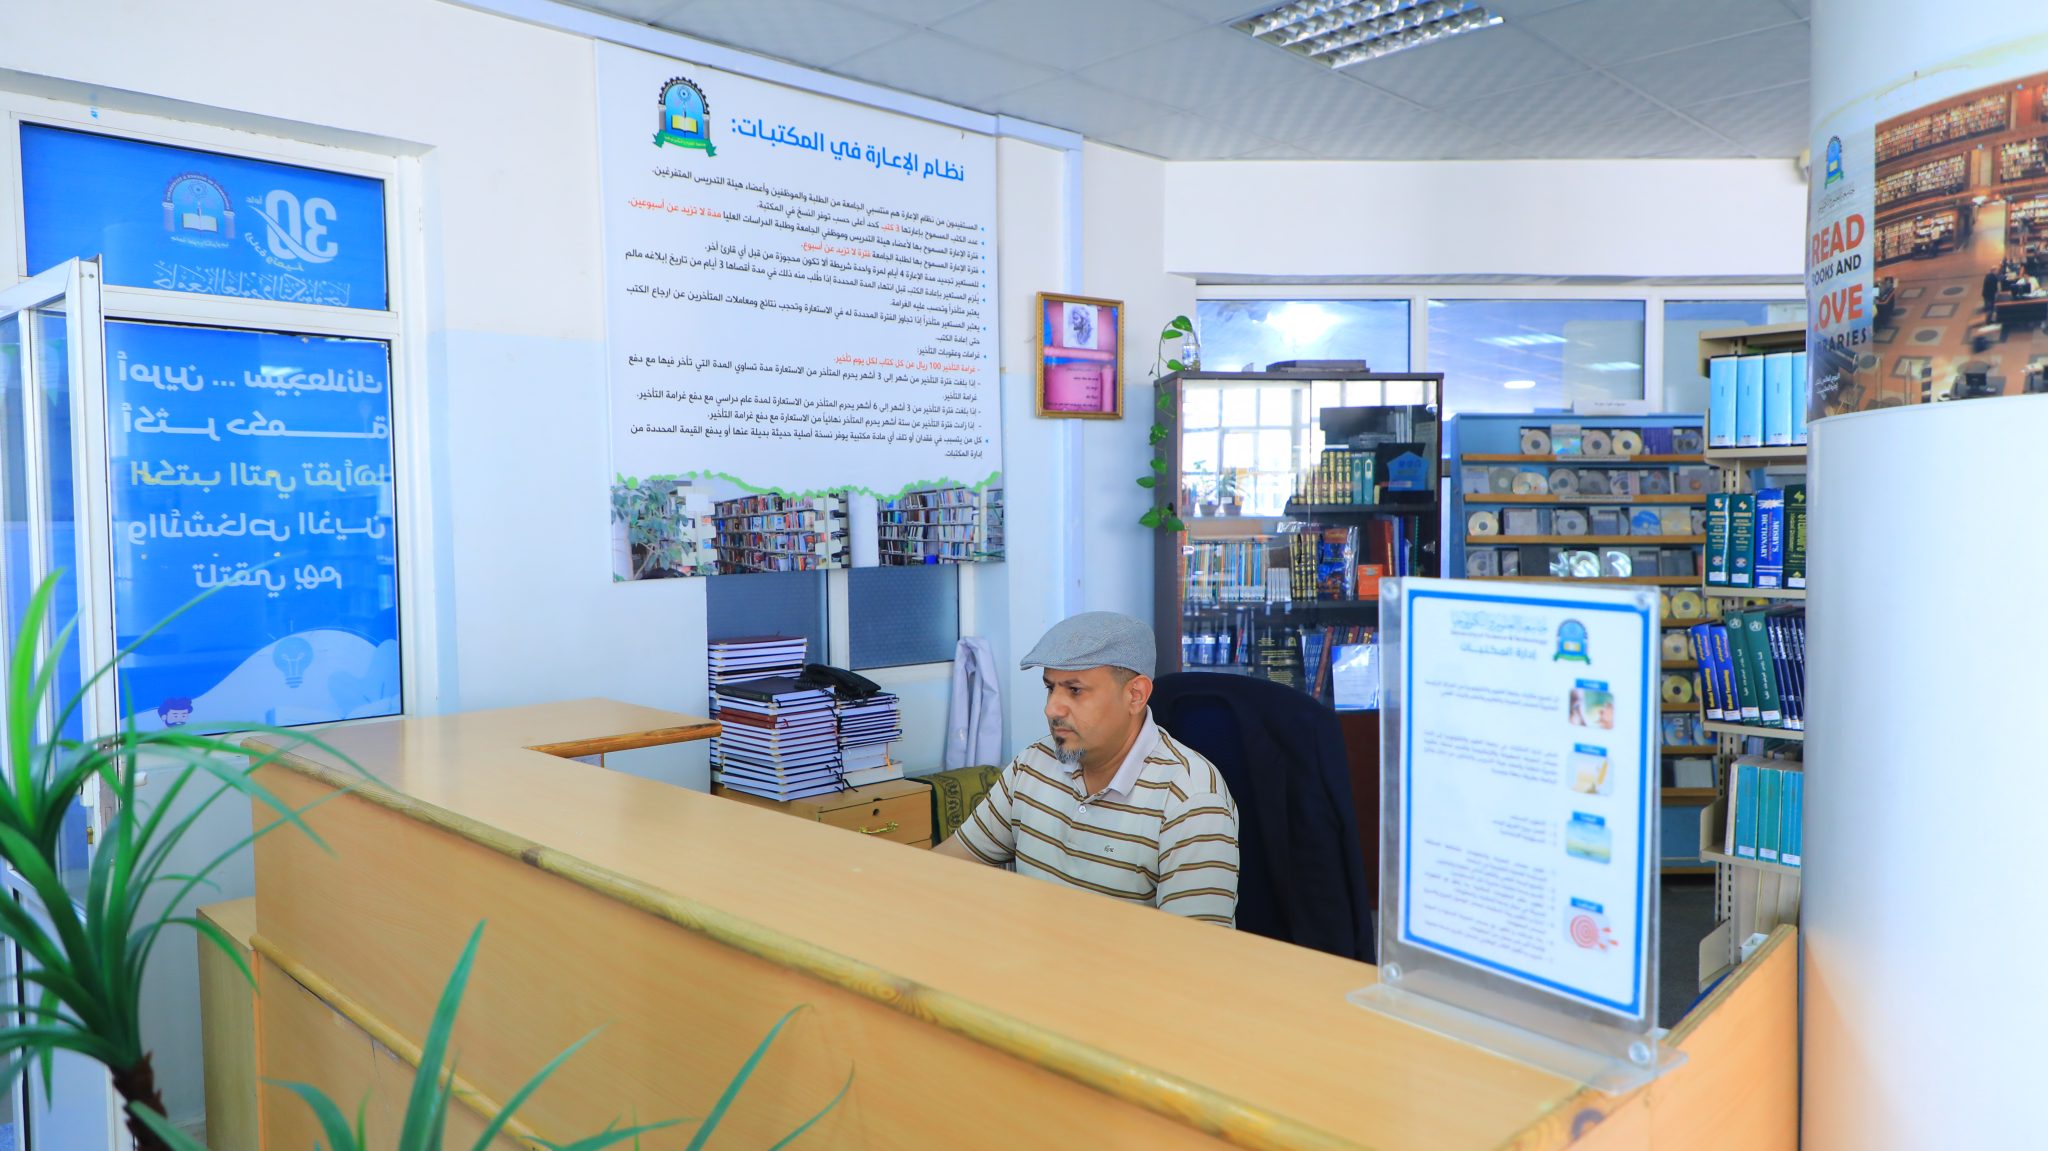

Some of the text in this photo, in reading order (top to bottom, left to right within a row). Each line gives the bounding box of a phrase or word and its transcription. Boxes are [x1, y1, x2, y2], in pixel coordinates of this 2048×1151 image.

[731, 118, 824, 152] المكتبات:
[829, 140, 861, 160] في
[865, 144, 918, 175] الإعارة
[922, 158, 964, 182] نظام
[1812, 214, 1865, 268] READ
[1836, 254, 1862, 276] AND
[1814, 284, 1863, 332] OVE
